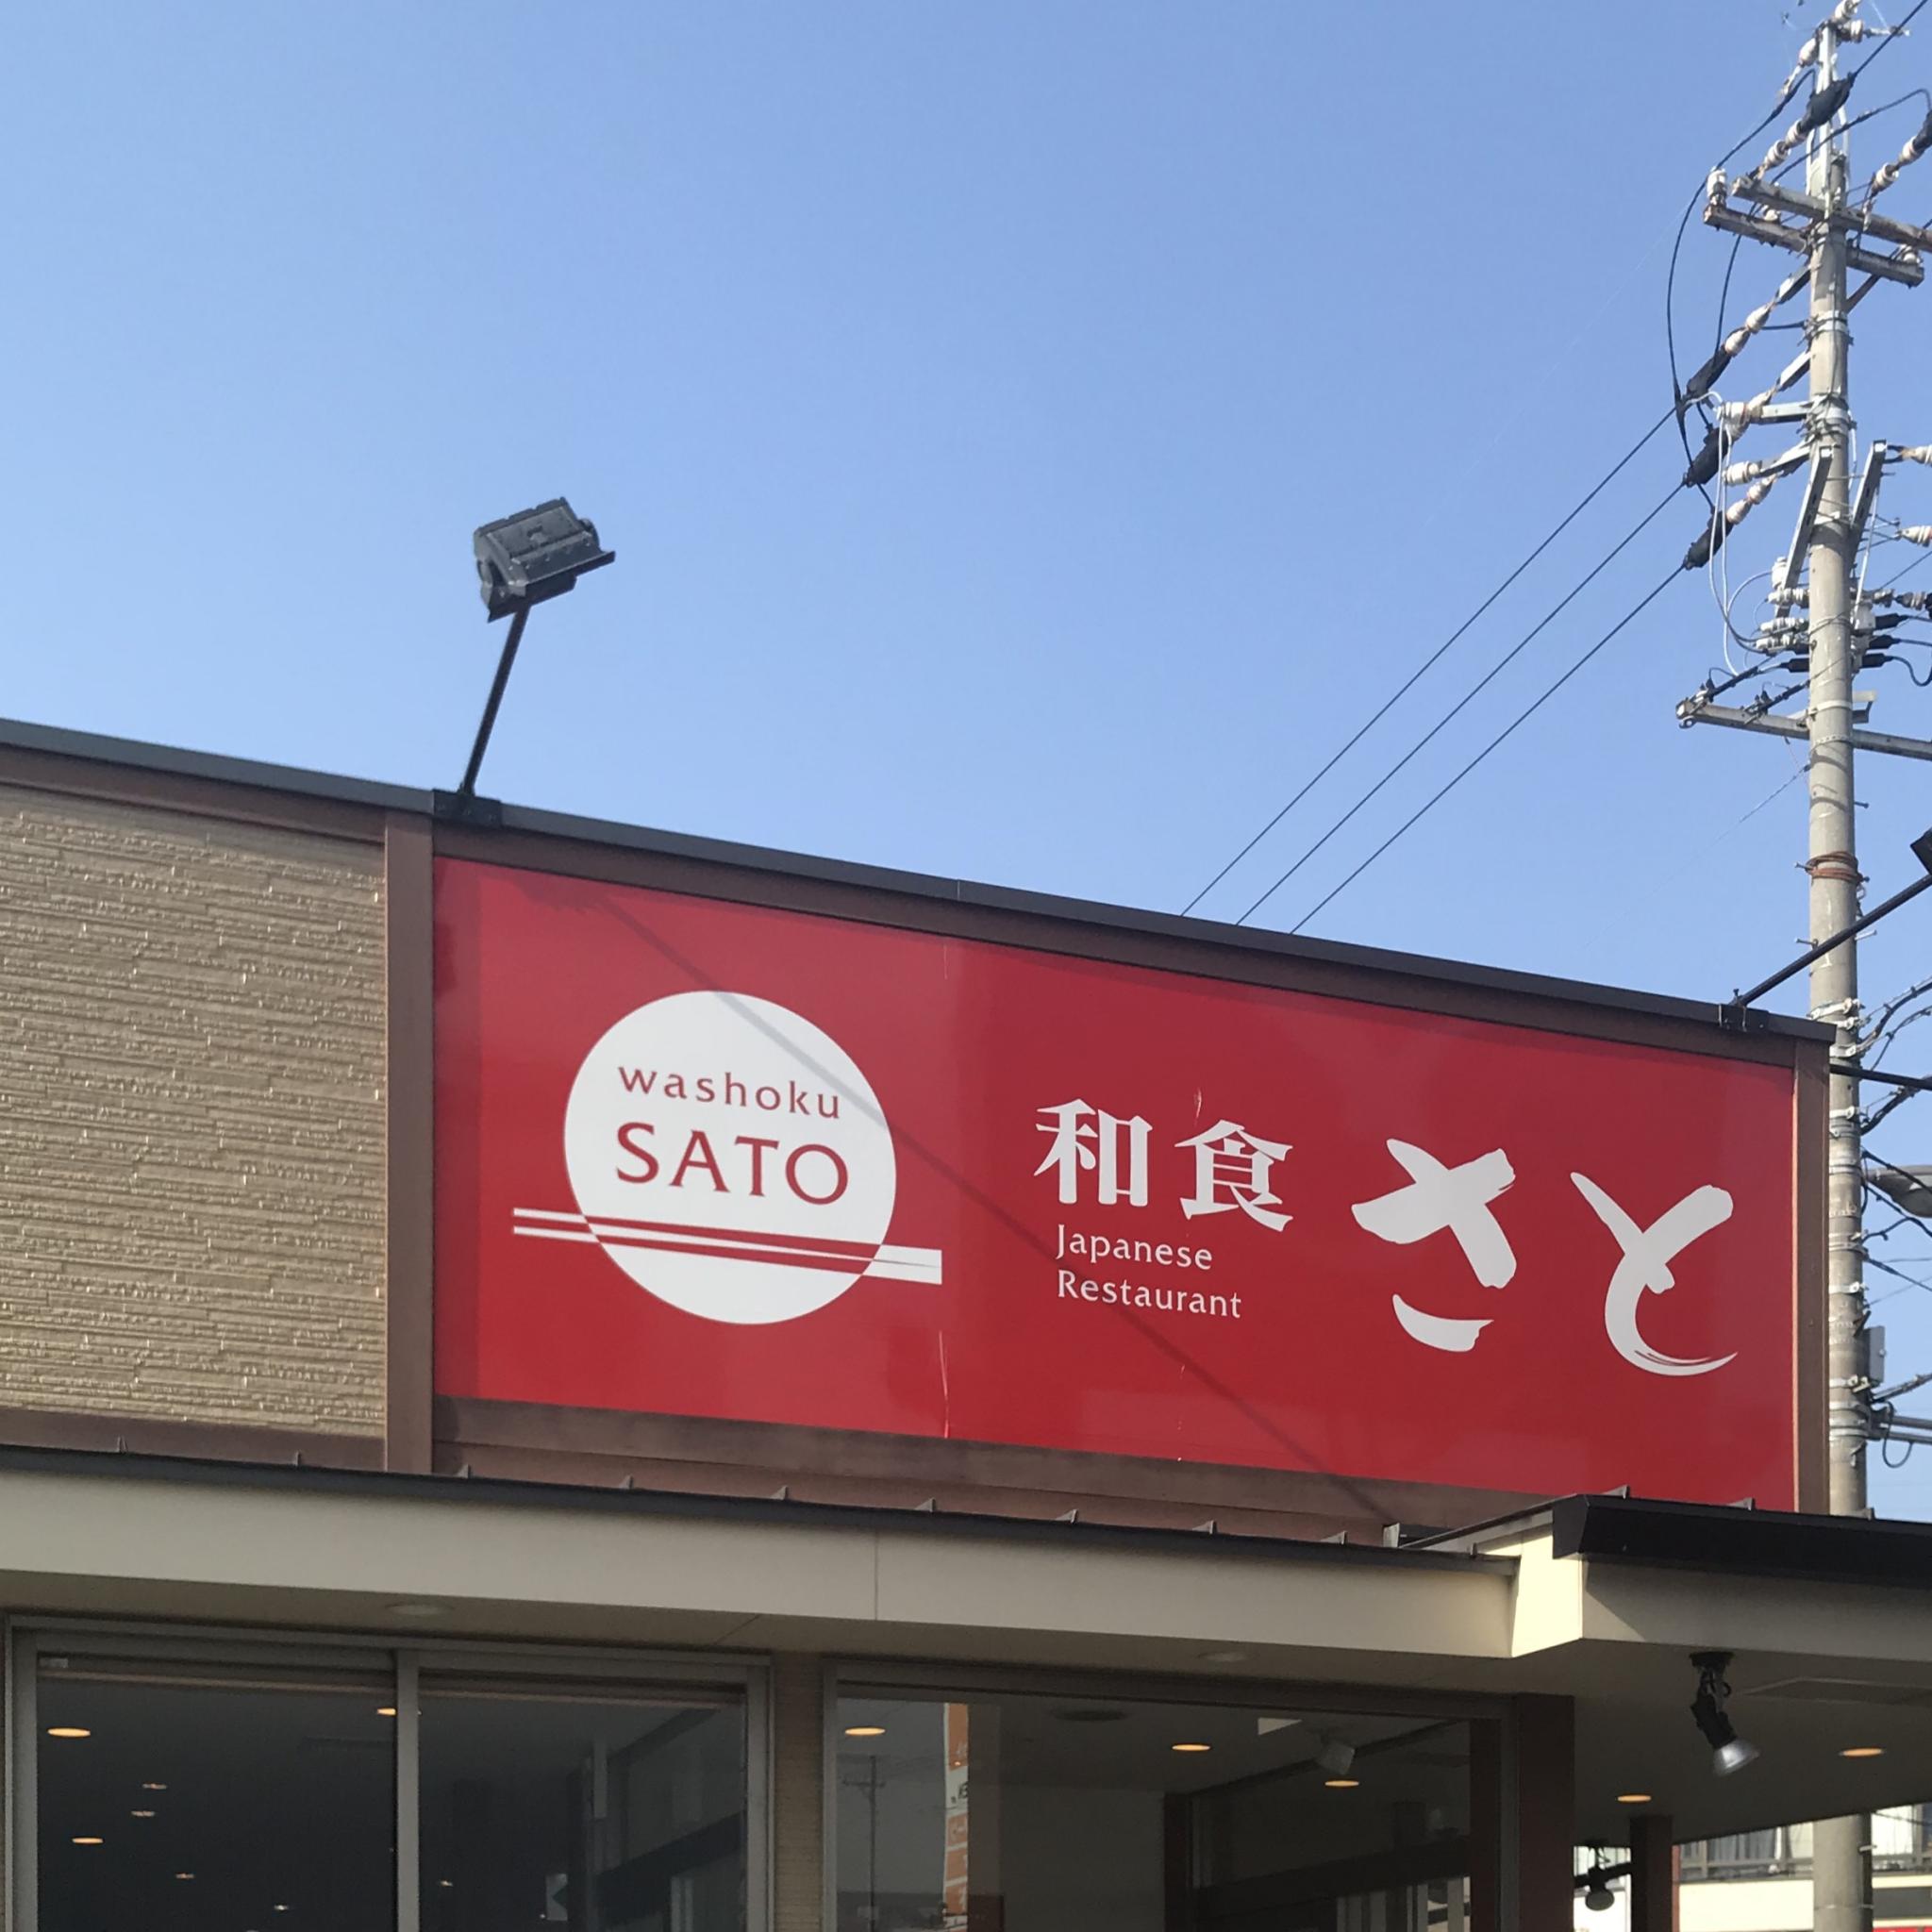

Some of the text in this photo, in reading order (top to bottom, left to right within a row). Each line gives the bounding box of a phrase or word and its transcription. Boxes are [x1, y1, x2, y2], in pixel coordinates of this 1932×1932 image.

[618, 1066, 840, 1119] washoku
[616, 1122, 849, 1206] SATO
[1033, 1098, 1737, 1376] 和食 さと
[1056, 1224, 1212, 1271] Japanese
[1058, 1269, 1242, 1319] Restaurant
